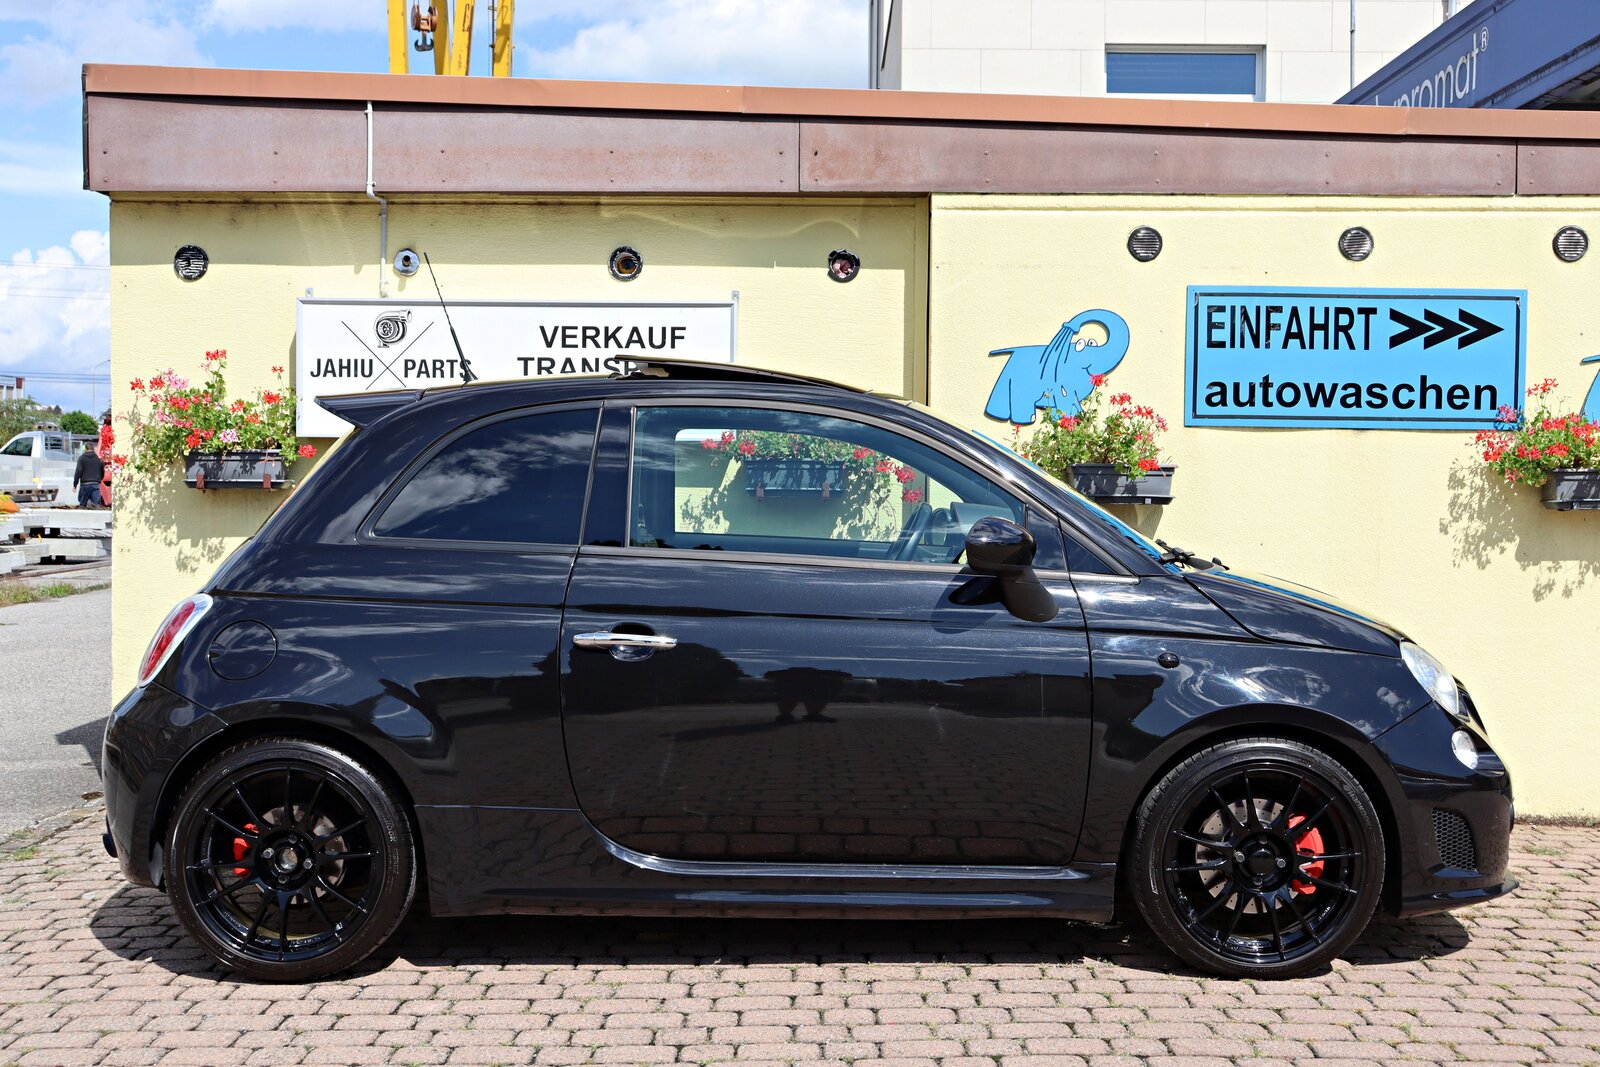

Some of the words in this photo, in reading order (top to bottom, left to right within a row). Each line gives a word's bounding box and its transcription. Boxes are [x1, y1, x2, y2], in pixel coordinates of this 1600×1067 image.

[539, 325, 686, 349] VERKAUF
[1206, 305, 1377, 350] EINFAHRT
[310, 358, 373, 378] JAHIU
[1204, 374, 1499, 410] autowaschen
